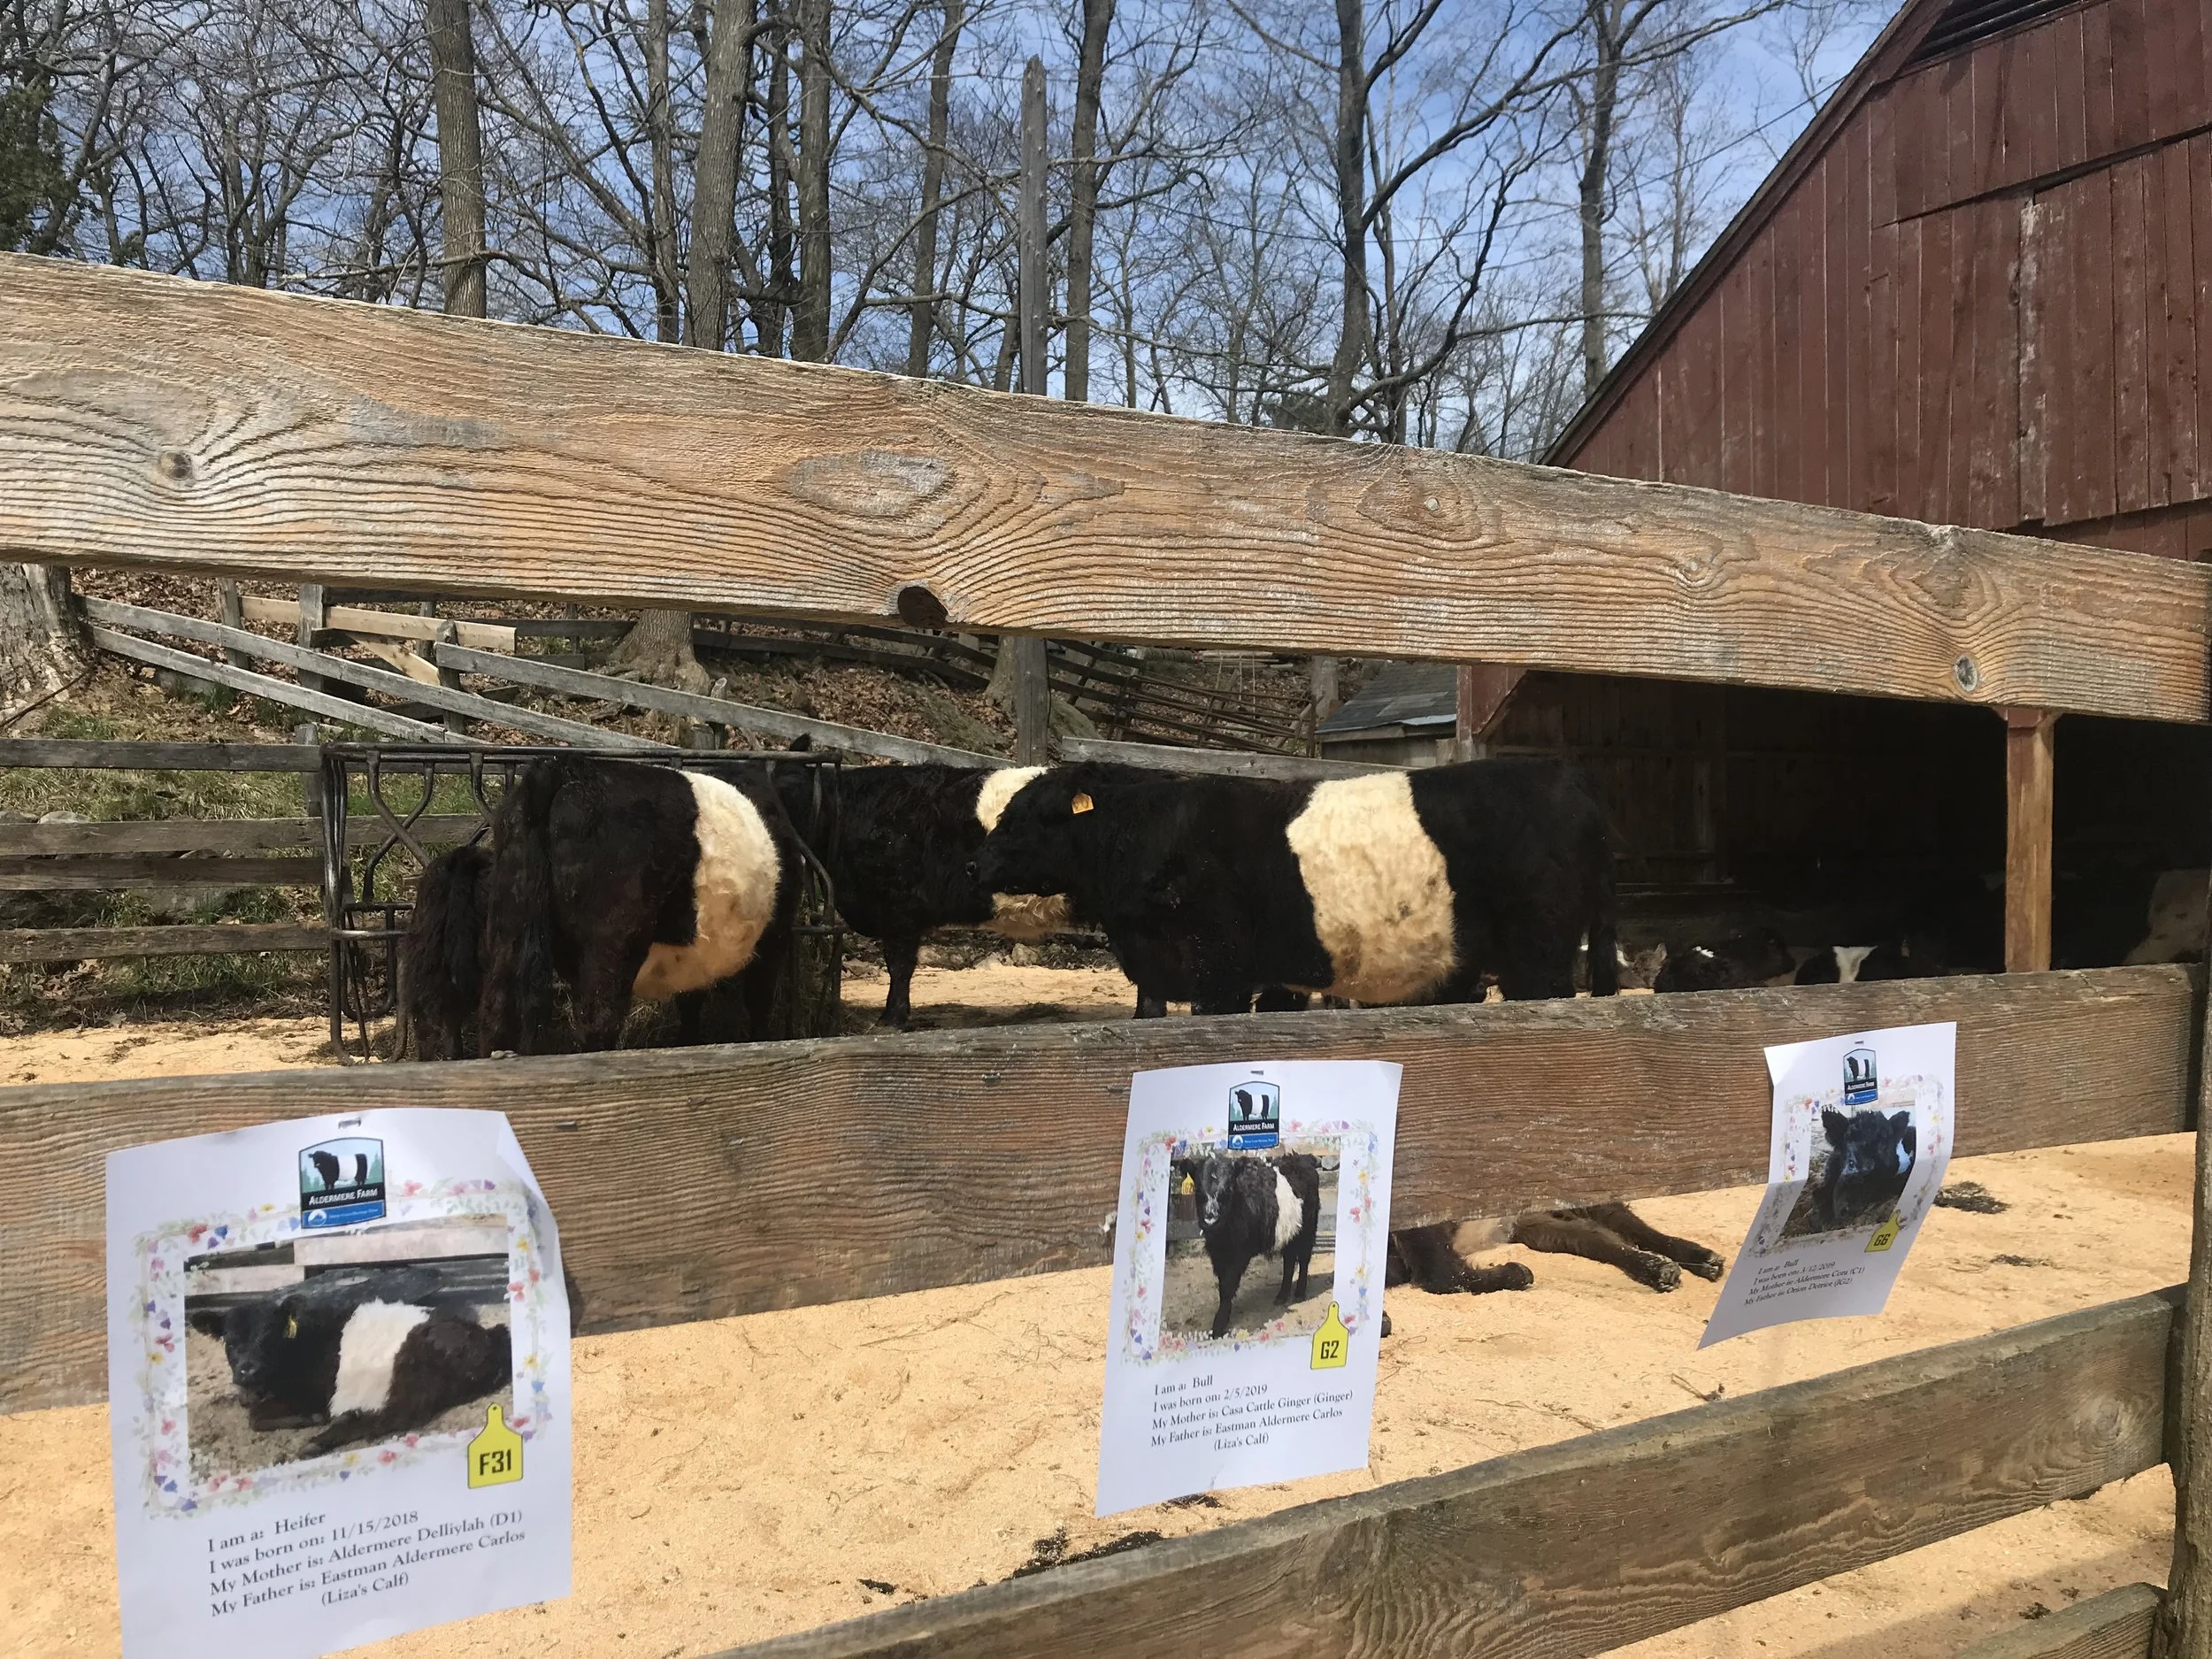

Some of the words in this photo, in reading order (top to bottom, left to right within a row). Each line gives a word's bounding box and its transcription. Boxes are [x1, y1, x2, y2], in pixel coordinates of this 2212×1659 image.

[309, 1192, 357, 1205] ALDERMERE
[357, 1188, 379, 1199] FARM
[1873, 1233, 1891, 1247] G6
[1784, 1258, 1800, 1268] Bull
[1796, 1273, 1831, 1284] Aldermere
[1320, 1340, 1340, 1360] G2
[1154, 1402, 1157, 1413] I
[1160, 1401, 1177, 1411] was
[1179, 1396, 1202, 1408] born
[1205, 1394, 1221, 1403] on:
[1224, 1383, 1268, 1400] 2/5/2019
[1155, 1384, 1159, 1395] I
[1161, 1386, 1176, 1395] am
[1193, 1374, 1213, 1388] Bull
[1152, 1417, 1168, 1430] My
[1171, 1411, 1206, 1426] Mother
[1209, 1409, 1218, 1419] is:
[1221, 1405, 1243, 1417] Casa
[1246, 1399, 1276, 1413] Cattle
[1278, 1397, 1311, 1409] Ginger
[1313, 1389, 1353, 1405] (Ginger)
[1151, 1434, 1167, 1448] My
[1170, 1429, 1201, 1443] Father
[1202, 1426, 1212, 1436] is:
[1216, 1420, 1256, 1434] Eastman
[1259, 1413, 1310, 1428] Aldermere
[1312, 1407, 1343, 1420] Carlos
[1213, 1437, 1242, 1451] (Liza's
[1245, 1432, 1270, 1446] Calf)
[480, 1448, 511, 1476] F31
[208, 1539, 215, 1553] I
[219, 1534, 245, 1549] am
[250, 1530, 265, 1541] a:
[274, 1513, 326, 1535] Heifer
[209, 1560, 215, 1575] I
[221, 1555, 250, 1571] was
[255, 1543, 294, 1562] born
[299, 1536, 326, 1549] on:
[332, 1509, 419, 1541] 11/15/2018
[210, 1578, 236, 1596] My
[242, 1561, 302, 1586] Mother
[307, 1555, 324, 1569] is:
[328, 1534, 412, 1563] Aldermere
[418, 1517, 485, 1542] Delliylah
[490, 1509, 523, 1528] (D1)
[211, 1602, 237, 1617] My
[243, 1585, 295, 1607] Father
[299, 1579, 316, 1592] is:
[320, 1562, 387, 1585] Eastman
[392, 1542, 473, 1568] Aldermere
[479, 1531, 526, 1548] Carlos
[320, 1583, 368, 1606] (Liza's
[373, 1572, 409, 1592] Calf)
